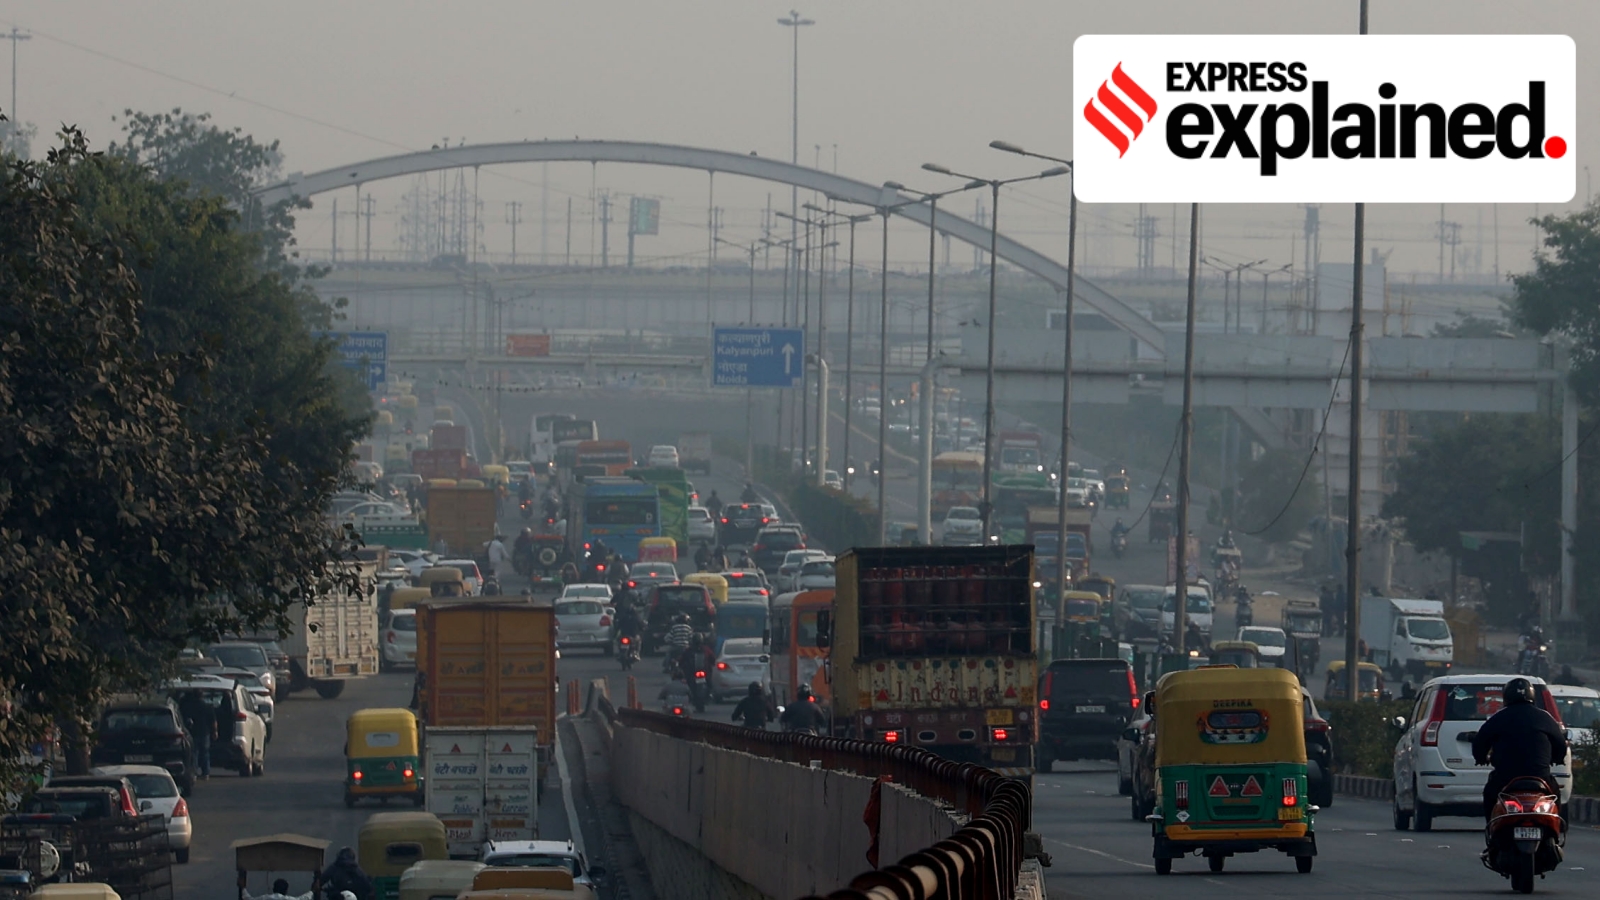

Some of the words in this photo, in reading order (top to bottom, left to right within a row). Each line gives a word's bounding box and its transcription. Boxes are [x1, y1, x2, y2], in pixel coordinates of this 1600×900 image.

[716, 345, 774, 358] Kalyanpuri
[717, 373, 748, 384] Noida
[897, 681, 997, 702] Indane
[1213, 699, 1253, 708] DEEPIKA
